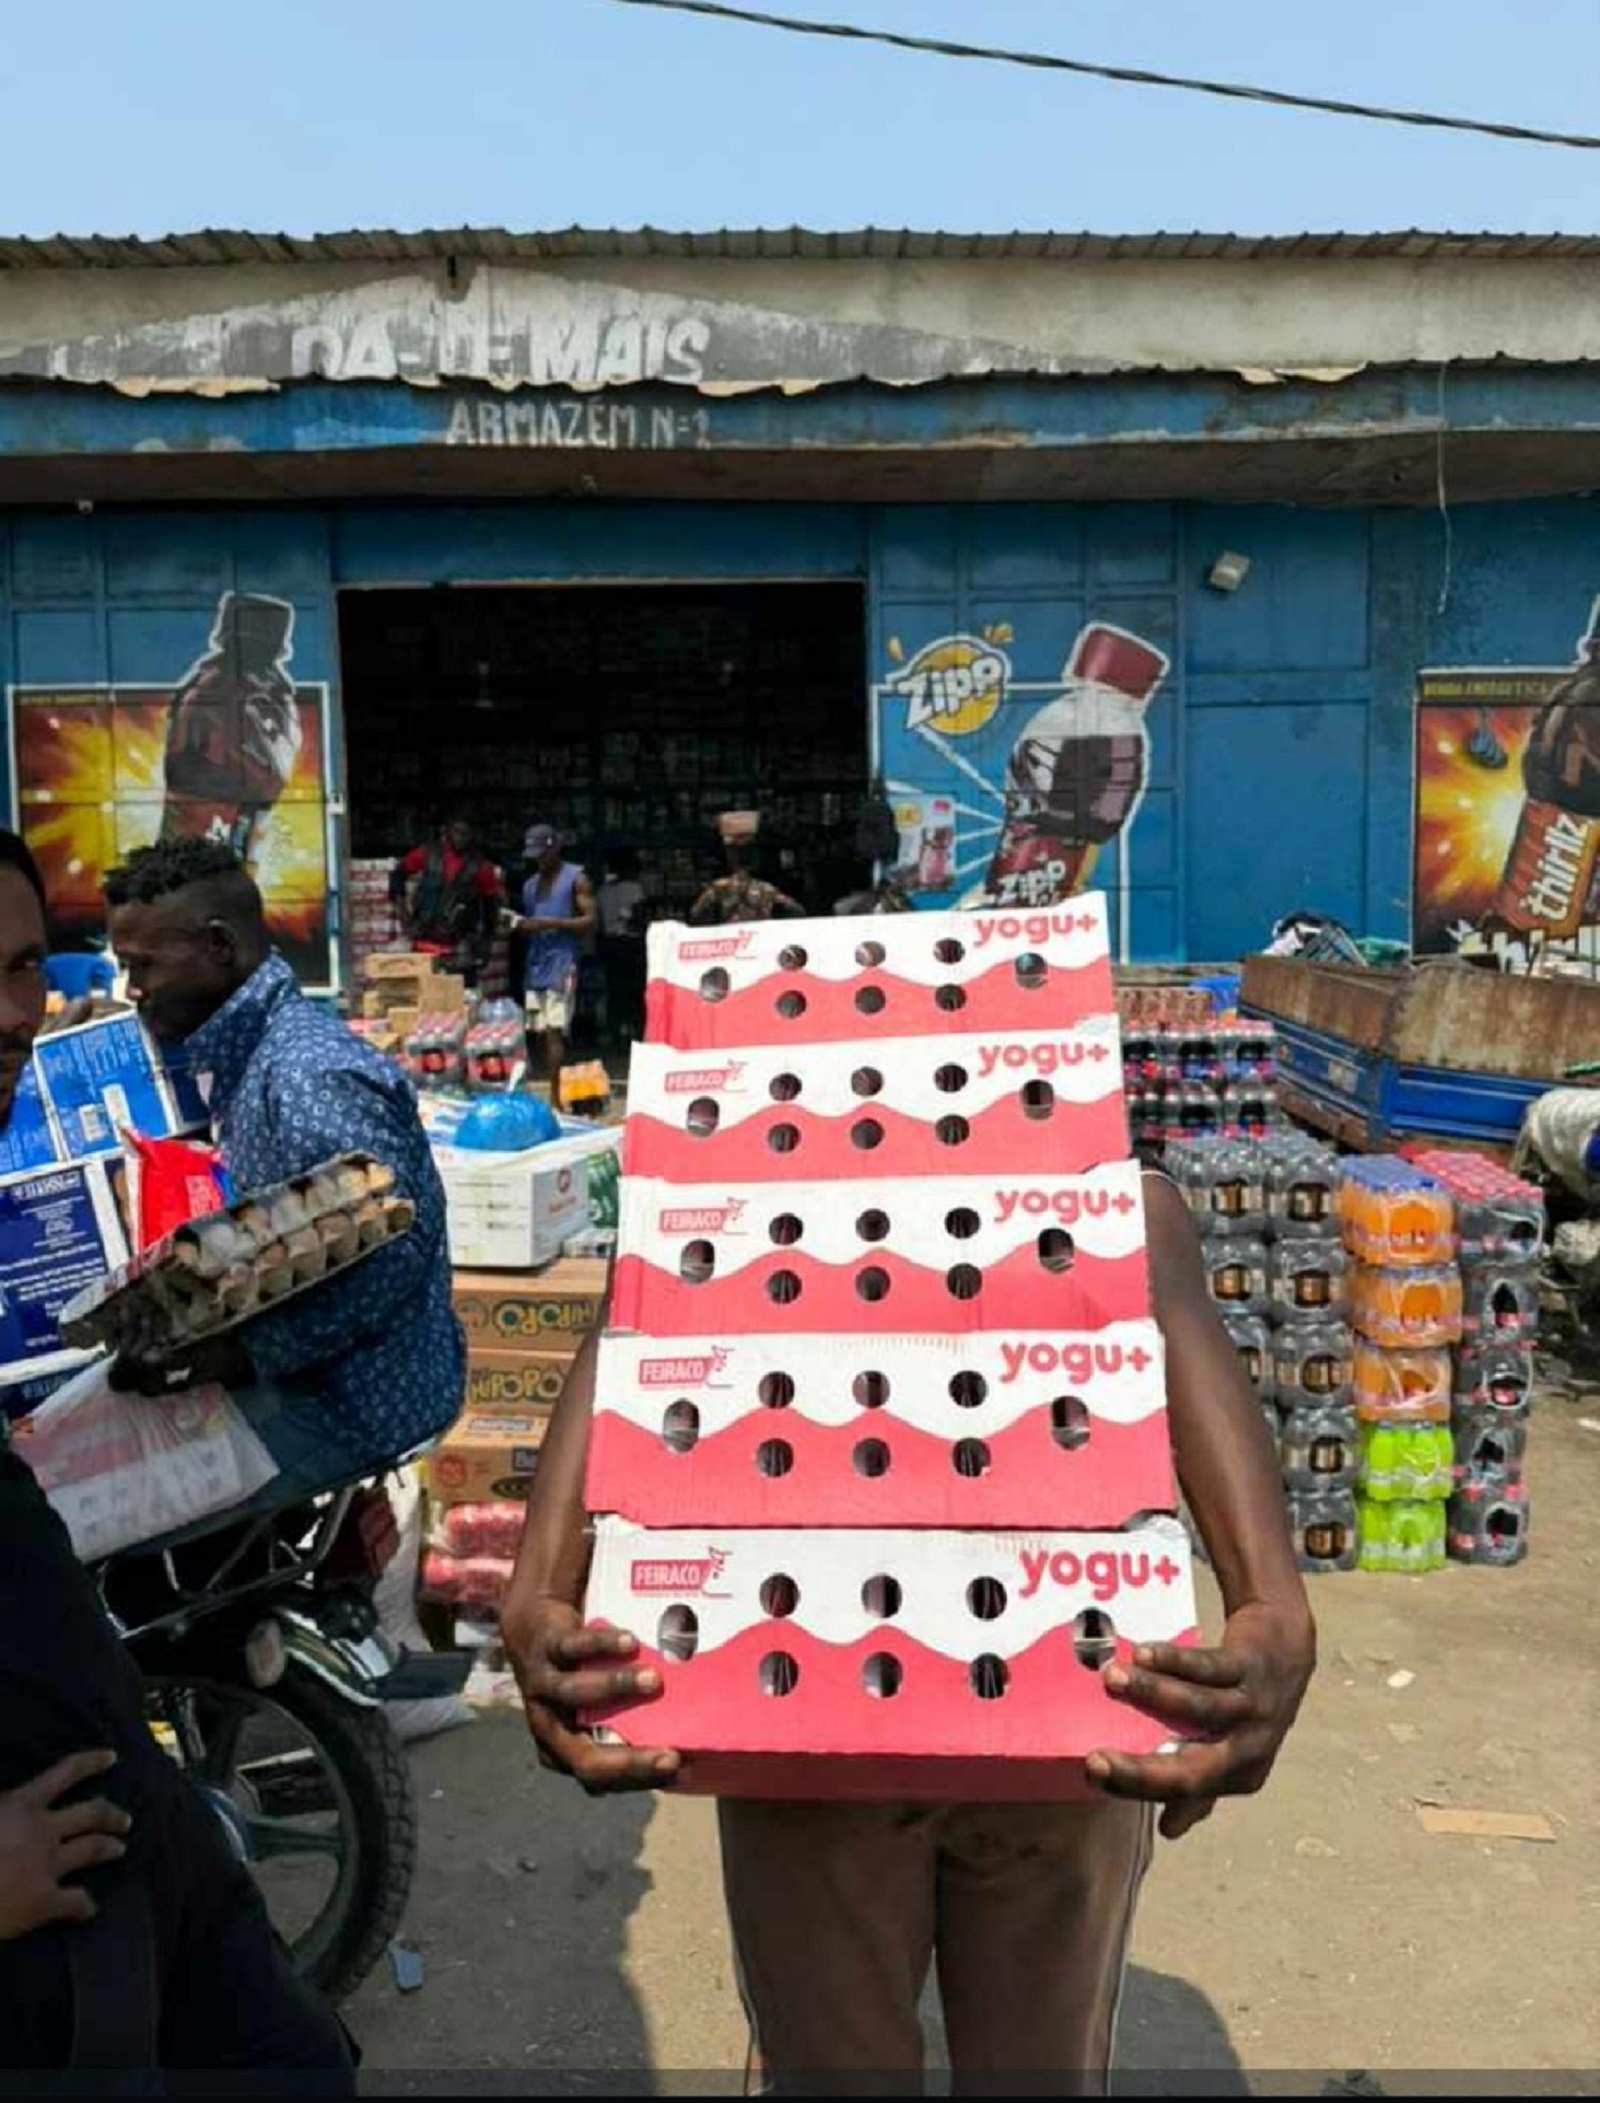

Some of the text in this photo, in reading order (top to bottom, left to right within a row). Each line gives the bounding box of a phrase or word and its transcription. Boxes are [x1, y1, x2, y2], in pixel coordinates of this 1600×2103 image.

[973, 913, 1099, 948] yogu+
[977, 1042, 1109, 1077] yogu+
[994, 1188, 1136, 1224] yogu+
[999, 1341, 1152, 1385] yogu+
[634, 1563, 701, 1586] FEIRACO
[1019, 1549, 1180, 1601] yogu+
